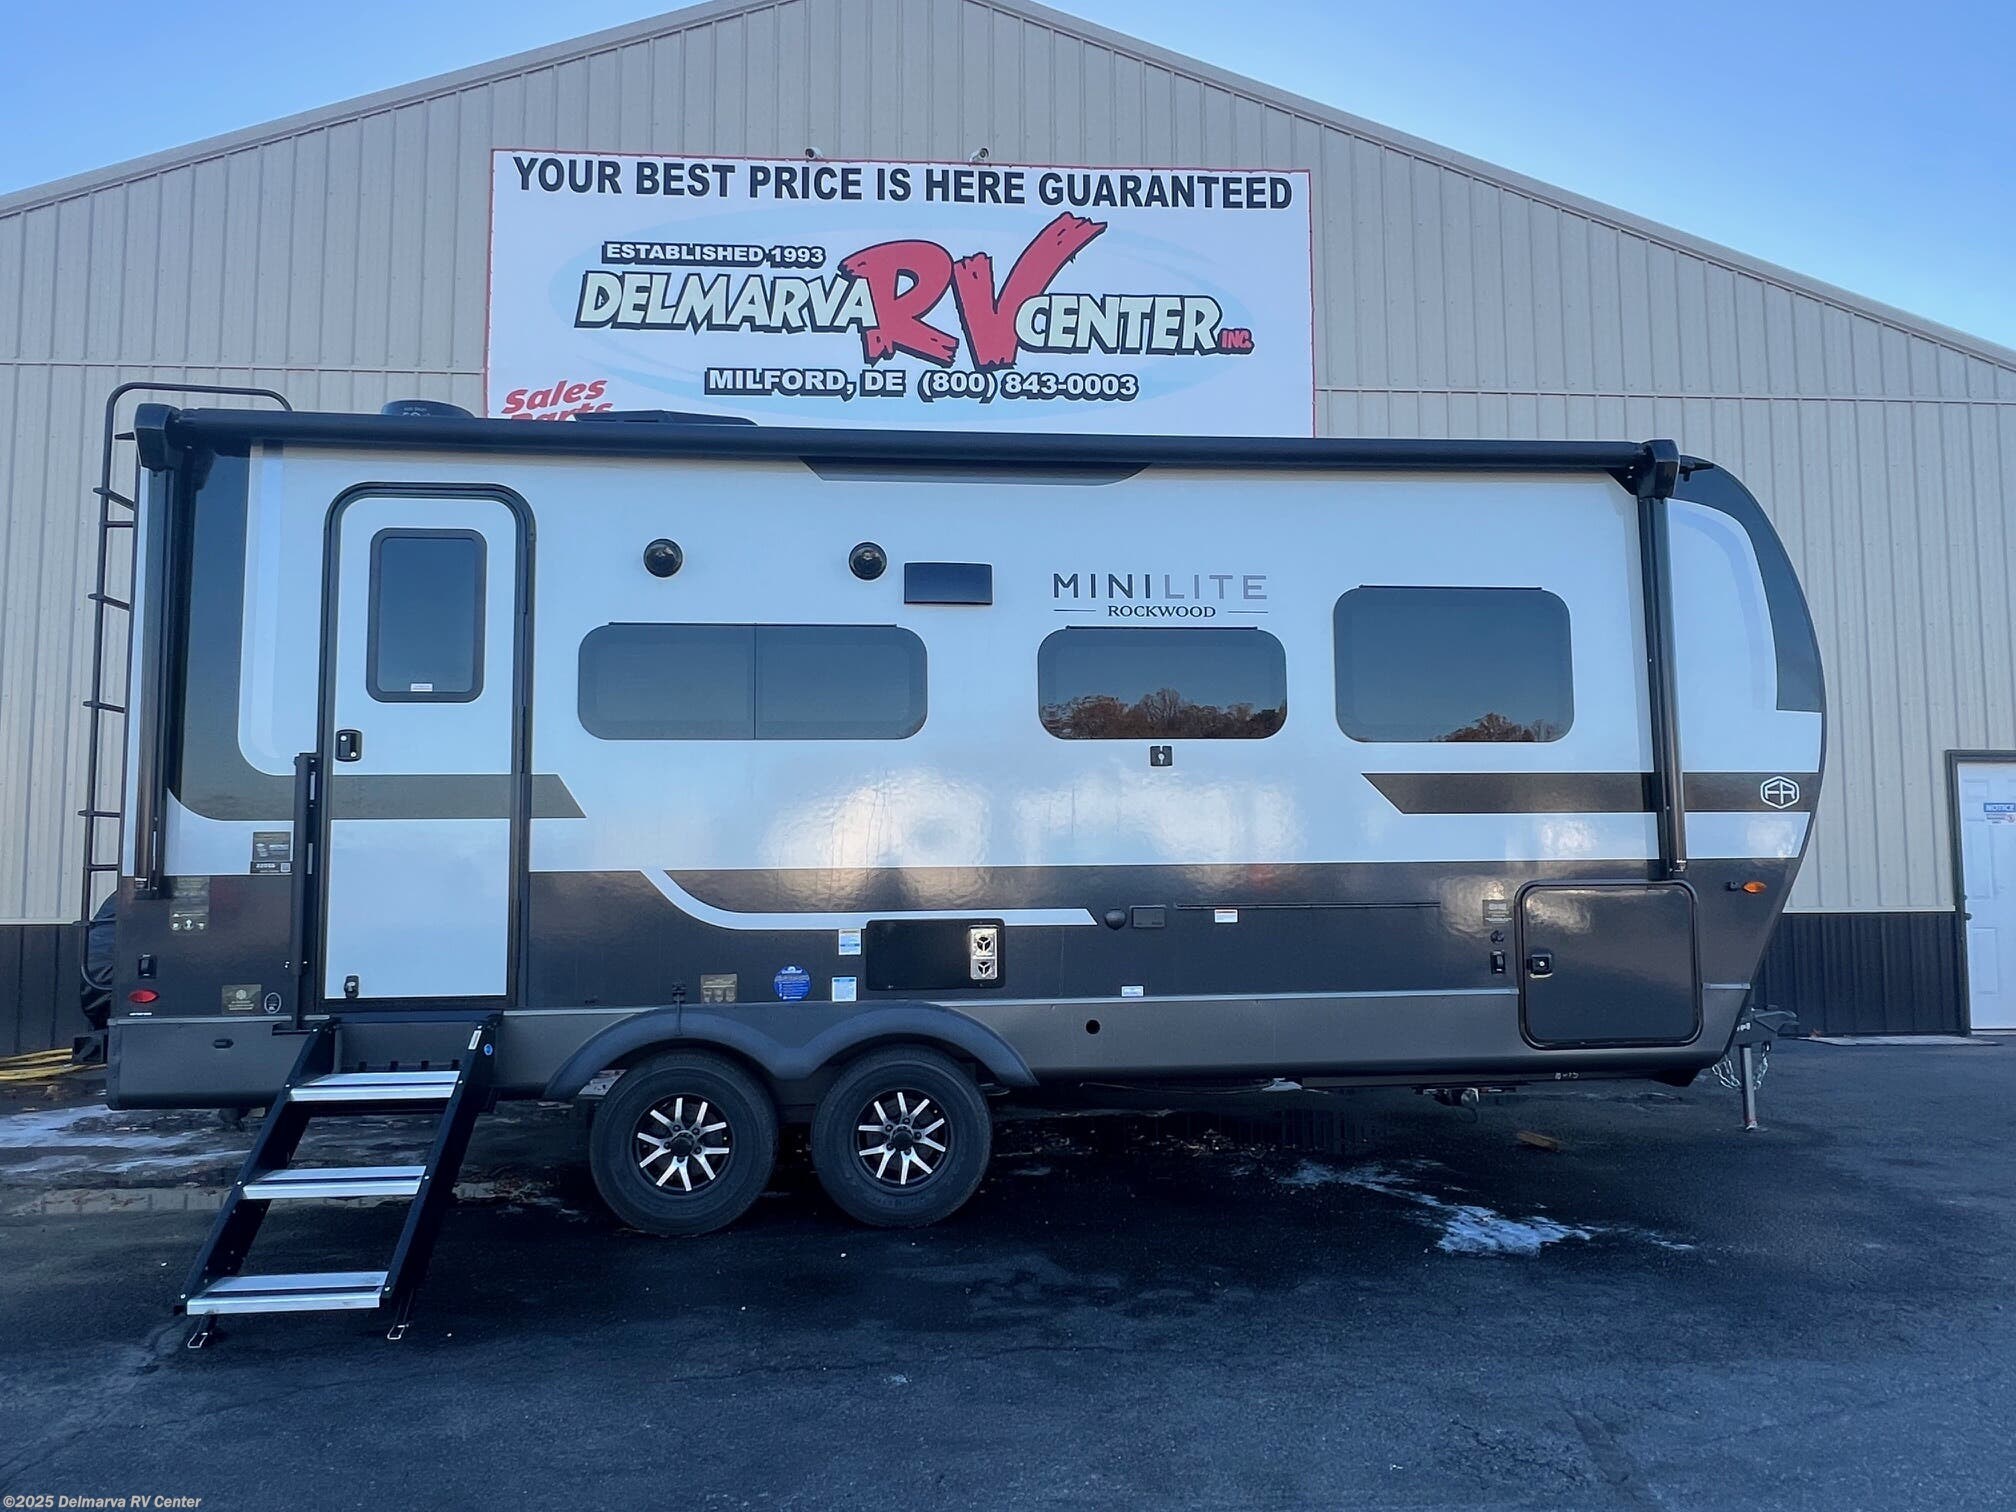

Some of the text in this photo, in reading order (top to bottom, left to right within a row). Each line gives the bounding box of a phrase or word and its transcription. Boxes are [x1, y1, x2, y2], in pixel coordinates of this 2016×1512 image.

[512, 156, 1293, 210] YOUR BEST PRICE IS HERE GUARANTEED
[605, 242, 825, 265] ESTABLISHED 1993
[577, 211, 1254, 370] DELMARVA RV CENTER INC.
[501, 379, 608, 414] Sales
[707, 368, 1138, 398] MILFORD, DE (800) 843-0003
[1052, 573, 1268, 600] MINILITE
[1107, 605, 1217, 618] ROCKWOOD
